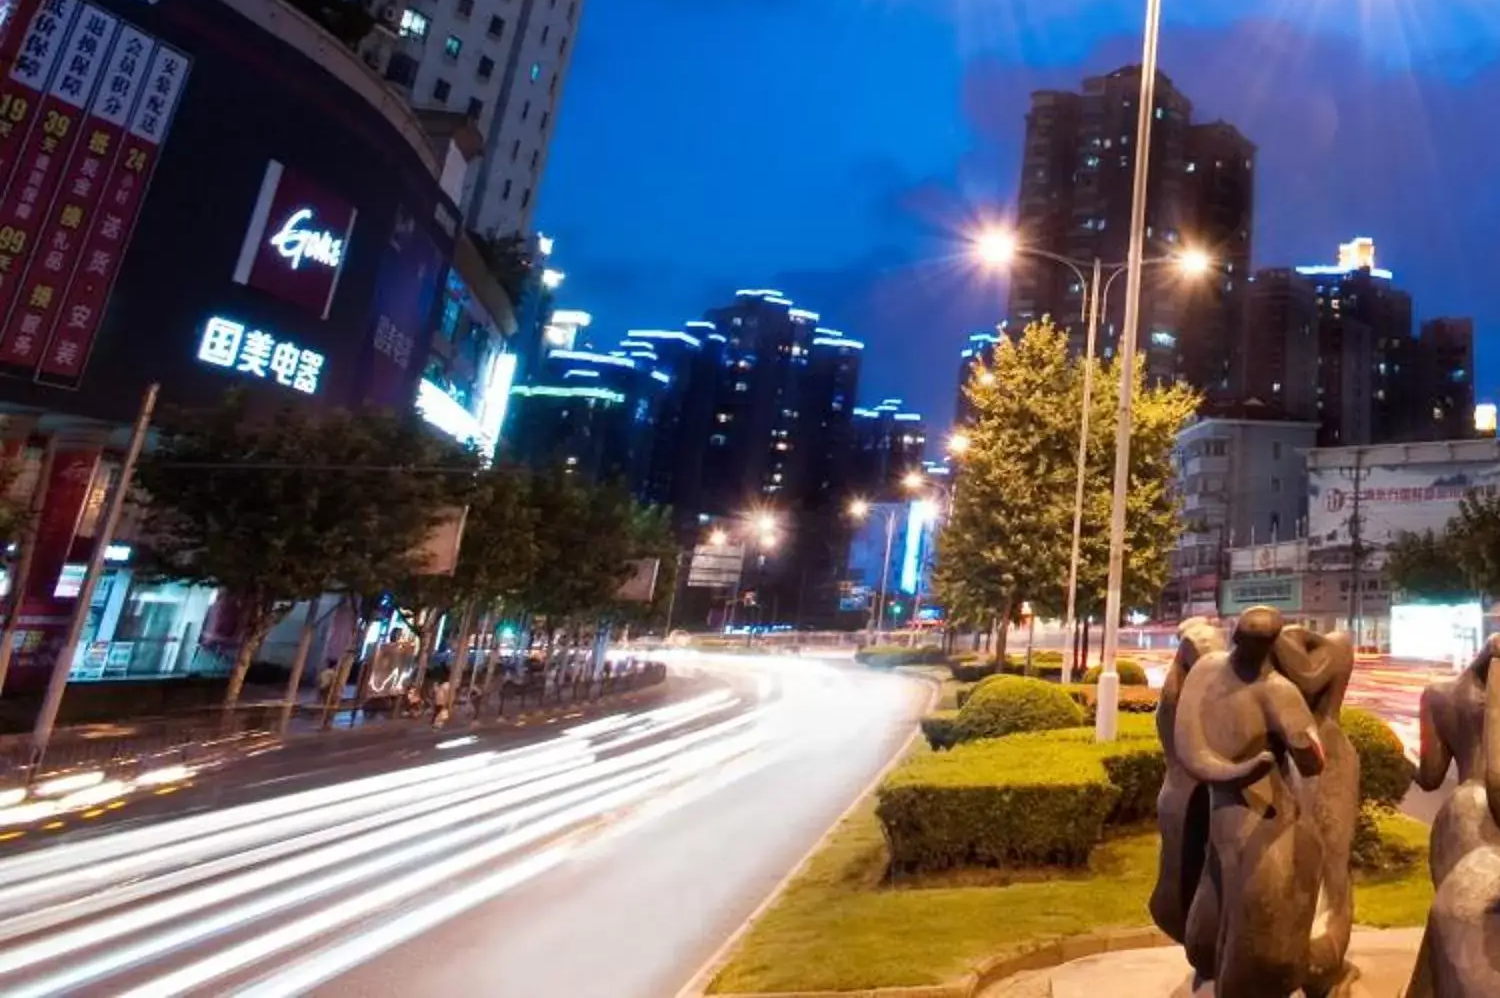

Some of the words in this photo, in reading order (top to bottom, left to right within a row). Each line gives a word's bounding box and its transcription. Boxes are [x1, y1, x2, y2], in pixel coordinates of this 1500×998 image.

[102, 37, 144, 116] 会员积分
[142, 57, 180, 136] 安装配送
[198, 316, 326, 395] 国美电器
